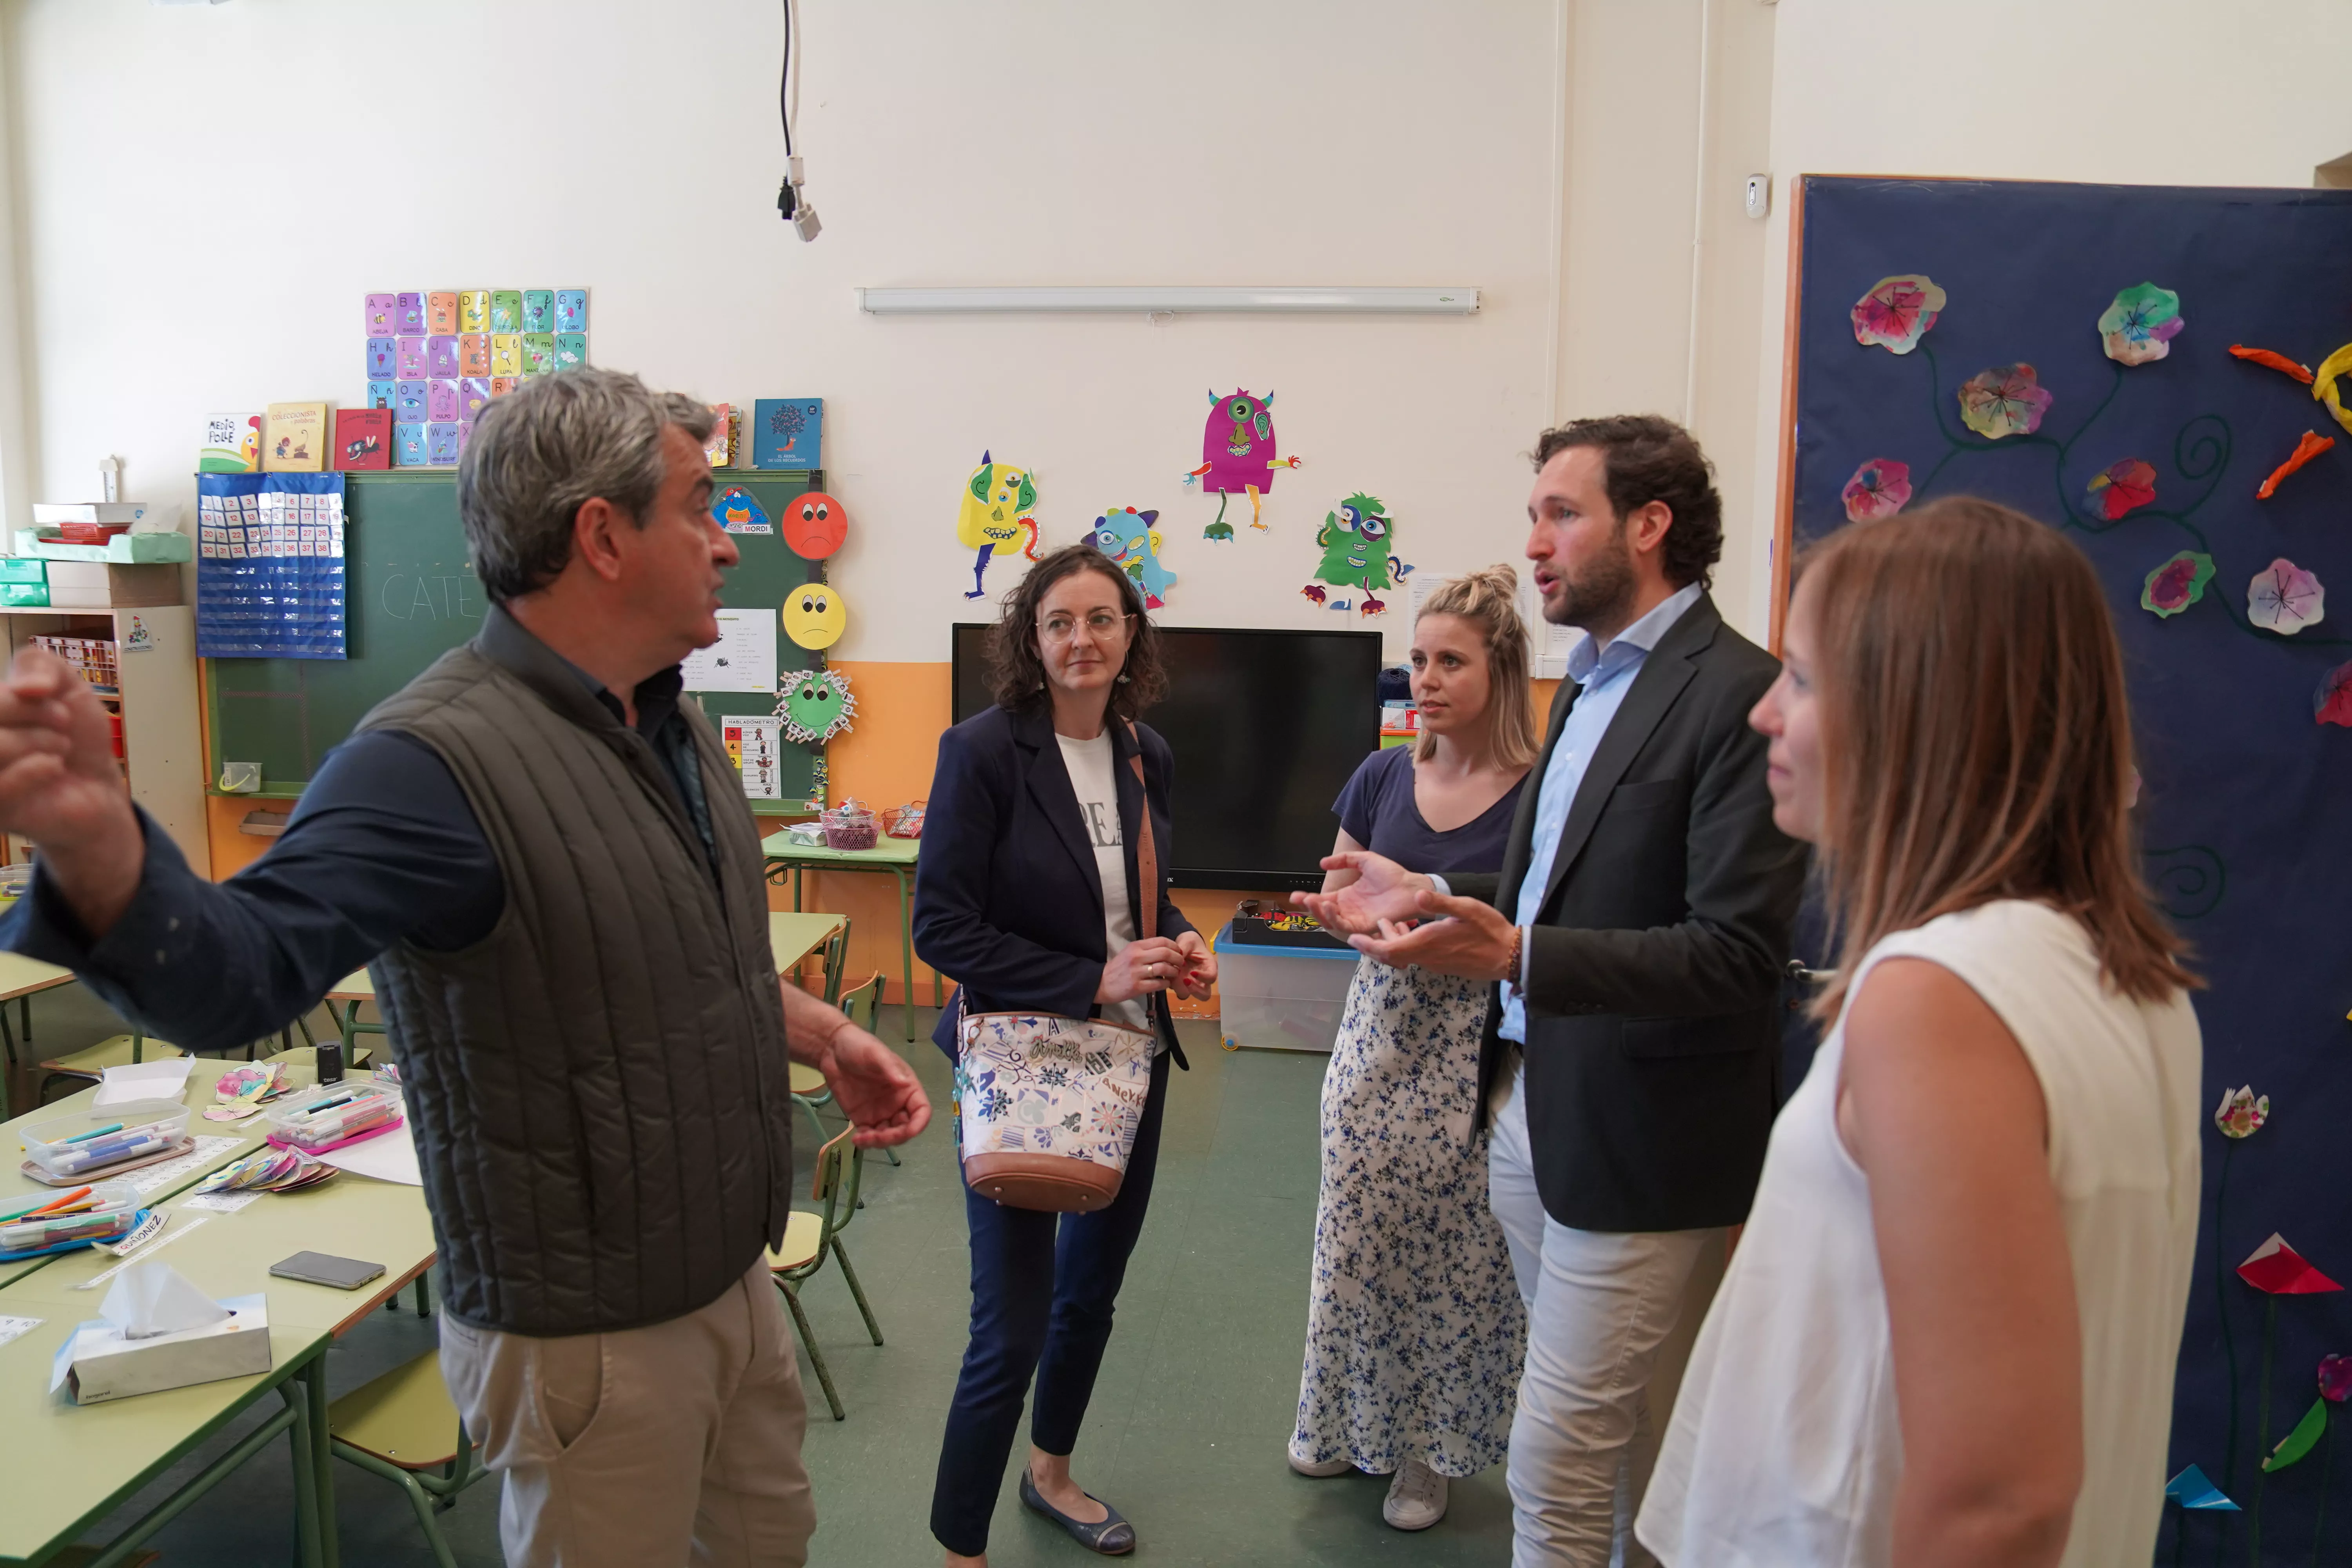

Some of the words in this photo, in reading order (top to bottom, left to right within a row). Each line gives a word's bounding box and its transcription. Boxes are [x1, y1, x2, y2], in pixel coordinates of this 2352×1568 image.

[368, 299, 376, 308] A
[400, 298, 407, 307] B
[431, 296, 438, 306] C
[463, 296, 470, 305] D
[479, 295, 487, 305] d
[496, 295, 502, 304] E
[528, 295, 534, 304] F
[544, 295, 551, 309] f
[559, 295, 566, 304] G
[576, 299, 584, 309] g
[370, 342, 377, 352] H
[386, 343, 394, 352] h
[402, 341, 406, 351] I
[432, 341, 438, 350] J
[464, 339, 470, 348] K
[496, 339, 502, 348] L
[526, 338, 534, 347] M
[559, 339, 566, 348] N
[400, 385, 408, 394] O
[433, 385, 438, 394] P
[448, 388, 455, 399] p
[463, 383, 470, 393] Q
[495, 383, 502, 392] R
[272, 410, 316, 421] COLECCIONISTA
[401, 428, 408, 437] V
[432, 428, 440, 437] W
[463, 426, 470, 436] X
[120, 1215, 161, 1249] QUIÑONEZ
